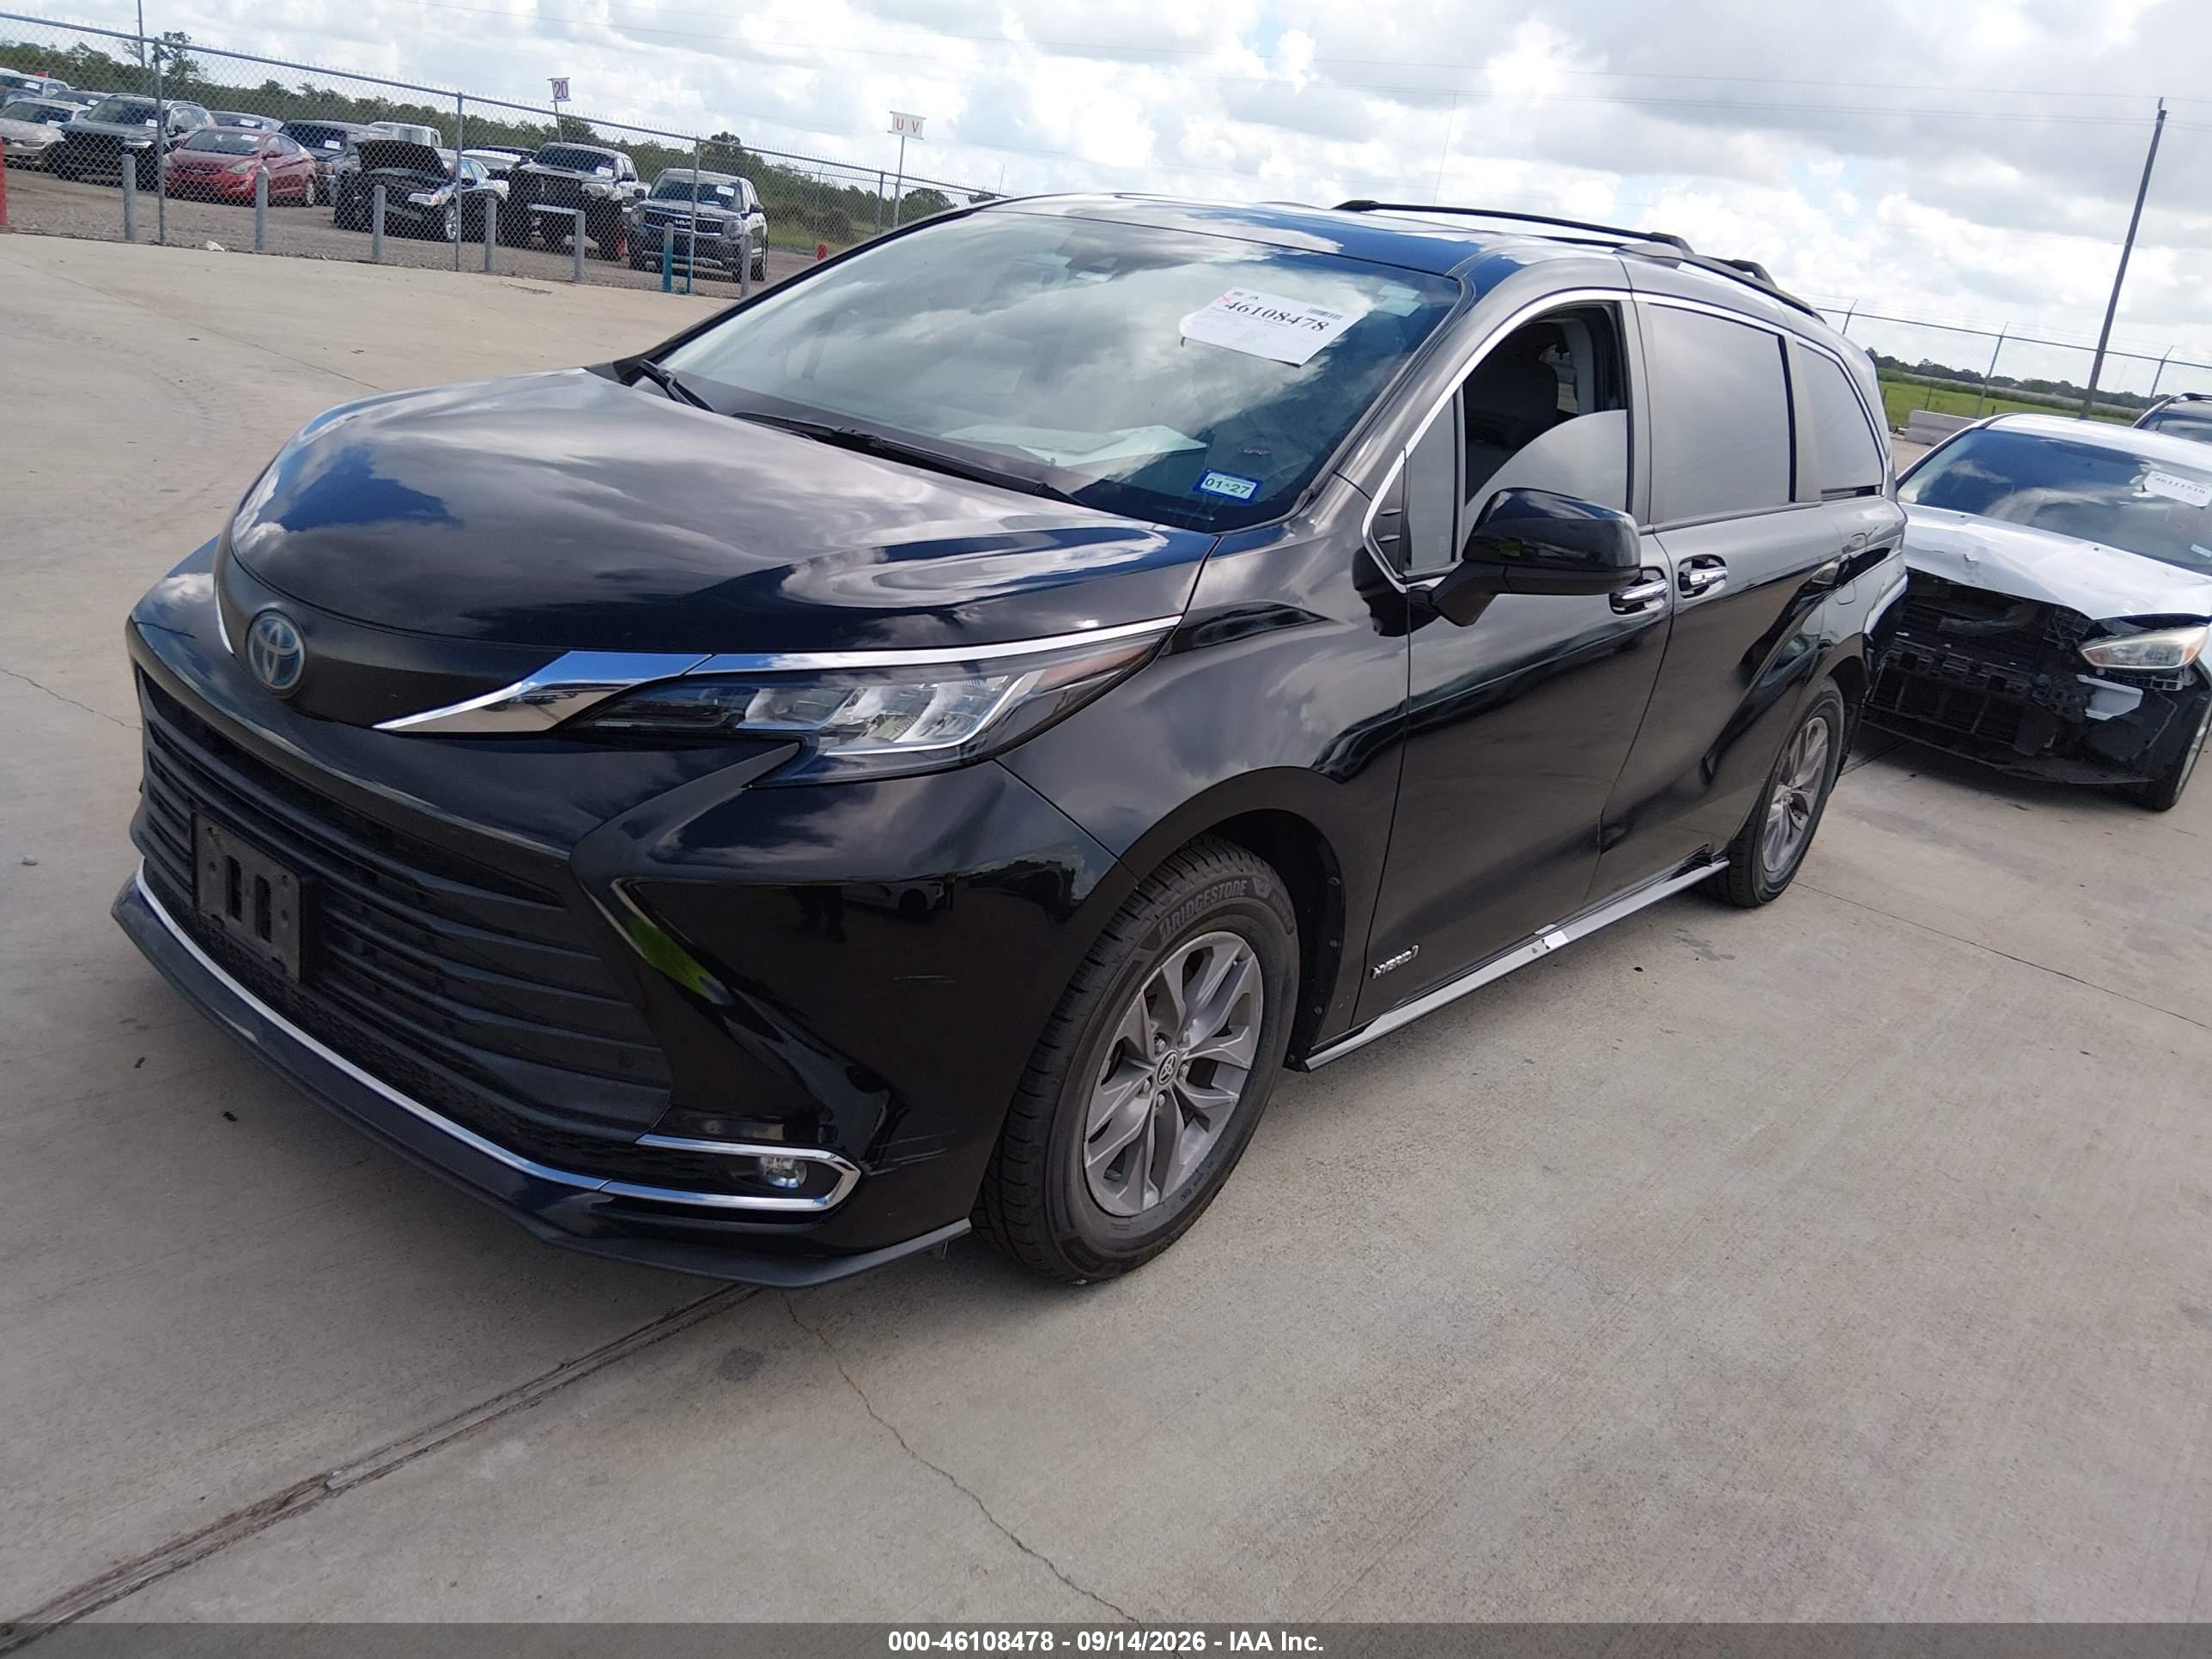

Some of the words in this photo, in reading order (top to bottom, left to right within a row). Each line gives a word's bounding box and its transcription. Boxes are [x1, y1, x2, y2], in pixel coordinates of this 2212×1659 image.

[554, 81, 568, 100] 20
[896, 118, 904, 131] U
[912, 120, 920, 133] V
[1224, 301, 1330, 332] 46108478
[1159, 879, 1249, 938] BRIDGESTONE
